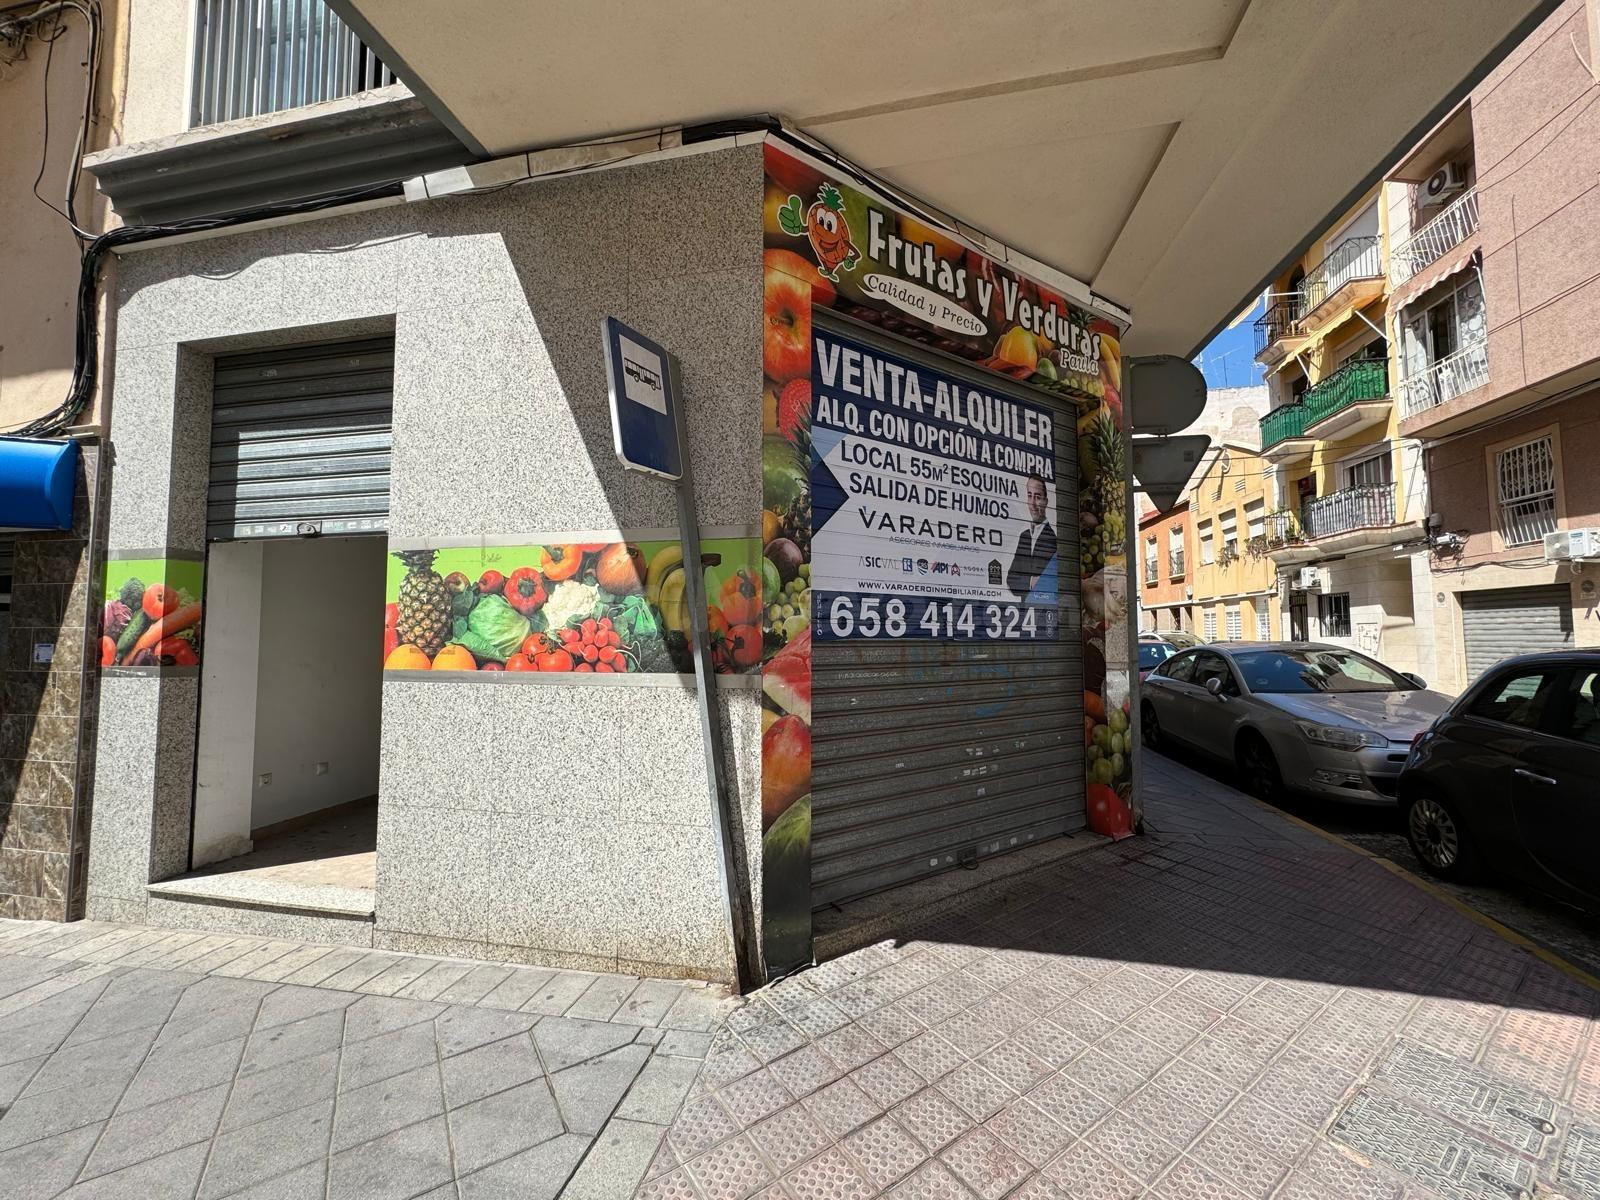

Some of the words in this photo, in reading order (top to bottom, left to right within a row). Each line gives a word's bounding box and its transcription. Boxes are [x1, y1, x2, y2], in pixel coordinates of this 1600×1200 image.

[867, 206, 967, 299] Frutas
[976, 277, 993, 318] y
[1001, 276, 1102, 361] Verduras
[867, 276, 926, 311] Calidad
[928, 303, 938, 320] y
[941, 307, 983, 335] Precio
[1060, 349, 1100, 376] Paula
[815, 337, 1054, 451] VENTA-ALQUILER
[816, 395, 865, 434] ALQ.
[869, 409, 909, 444] CON
[914, 422, 978, 462] OPCIÓN
[981, 440, 992, 465] A
[994, 443, 1054, 480] COMPRA
[840, 439, 908, 475] LOCAL
[951, 465, 1019, 498] ESQUINA
[849, 473, 920, 505] SALIDA
[924, 488, 948, 510] DE
[951, 491, 1010, 520] HUMOS
[858, 506, 1003, 547] VARADERO
[829, 596, 907, 638] 658
[919, 601, 976, 638] 414
[985, 604, 1037, 639] 324
